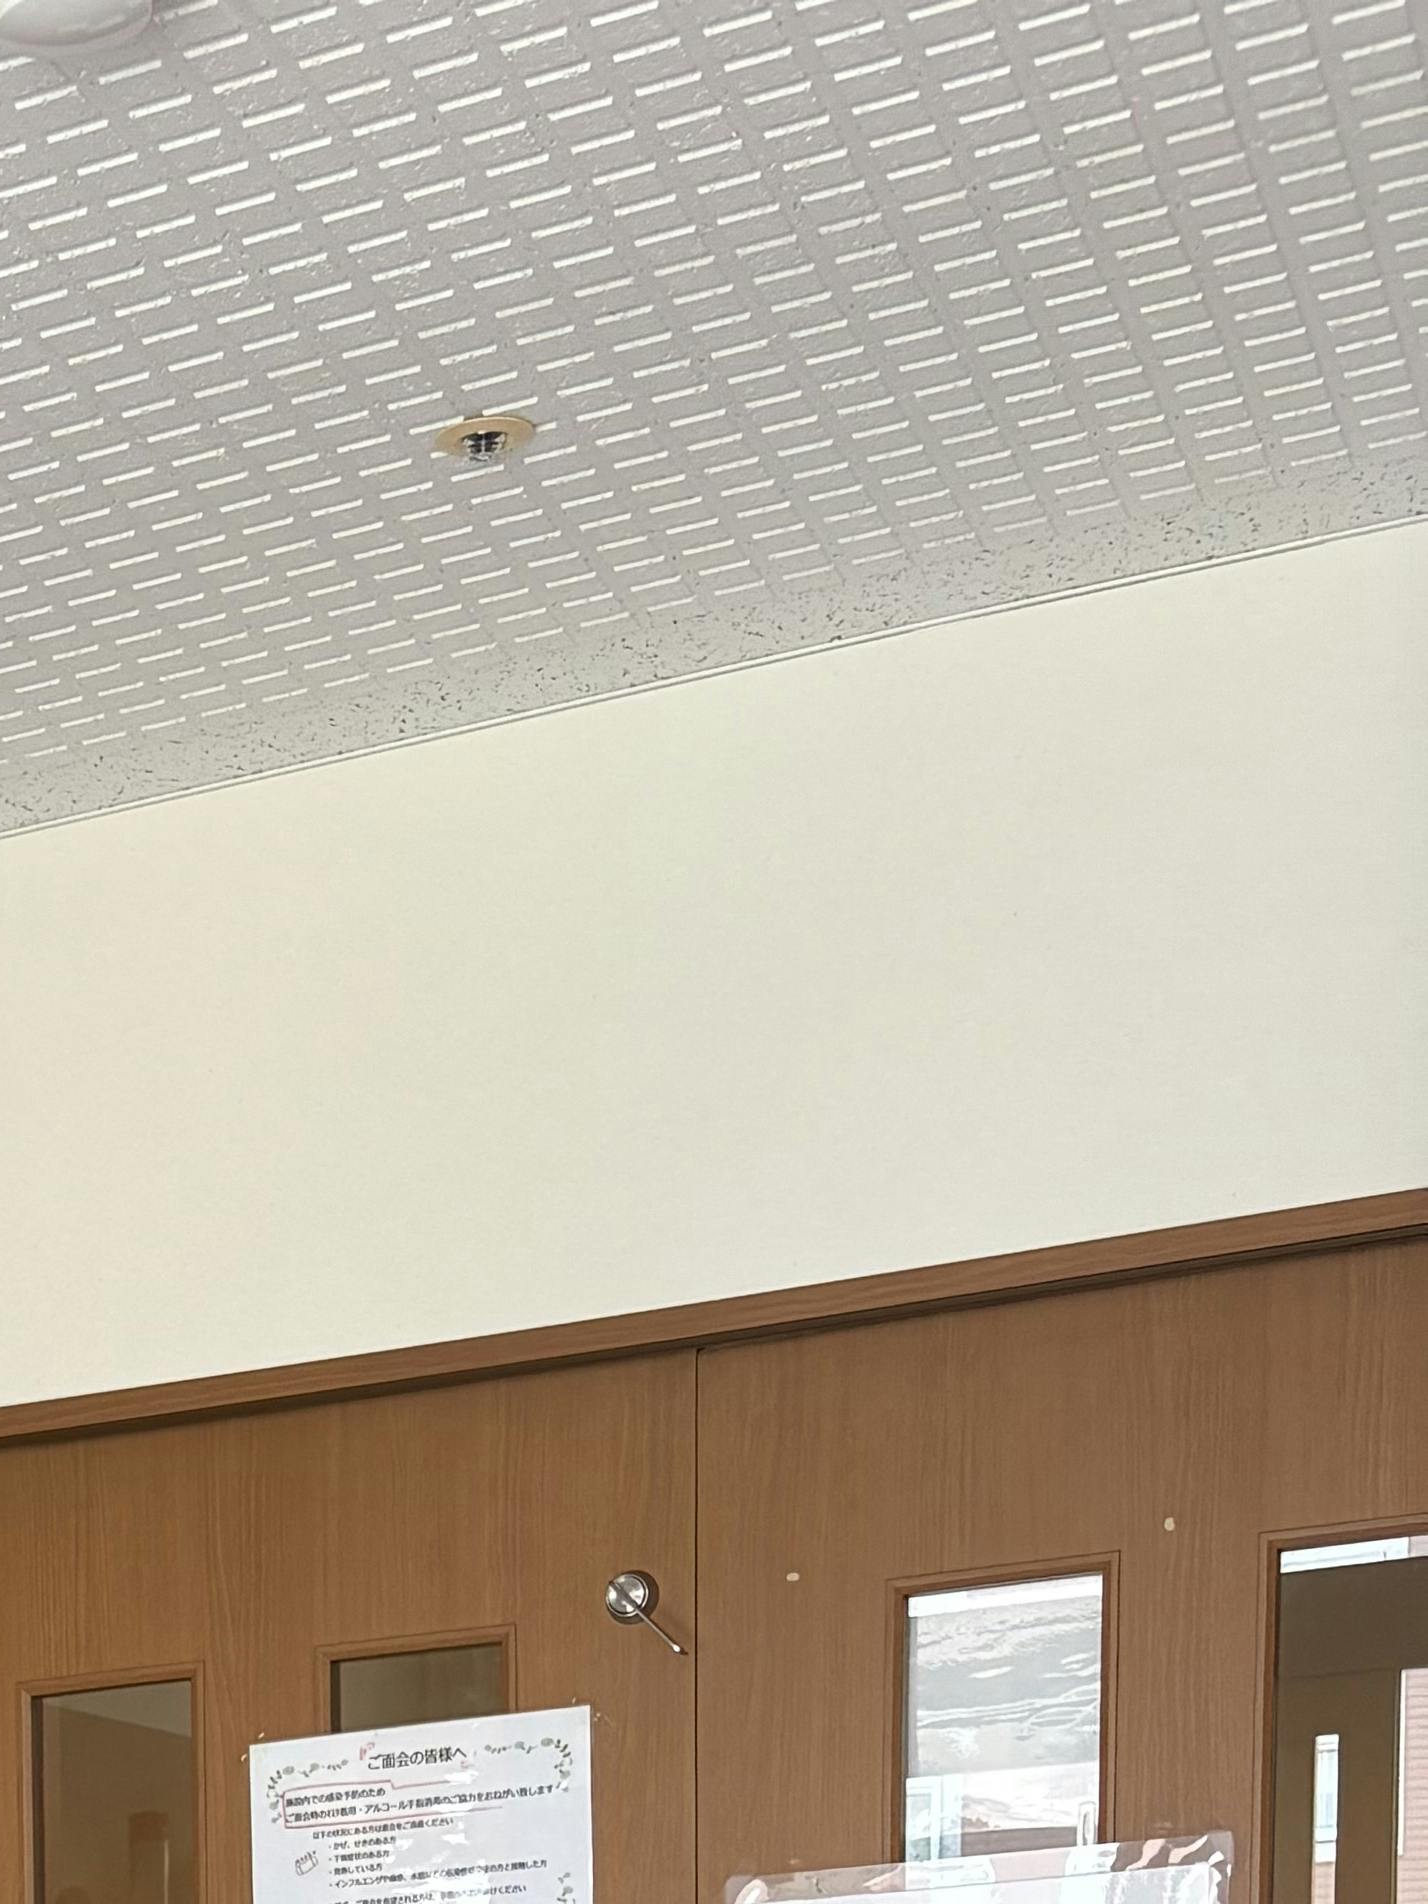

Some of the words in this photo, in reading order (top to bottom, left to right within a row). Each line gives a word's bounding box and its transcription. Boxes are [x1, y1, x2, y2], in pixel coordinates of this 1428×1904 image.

[367, 1745, 467, 1771] ご面会の皆様へ
